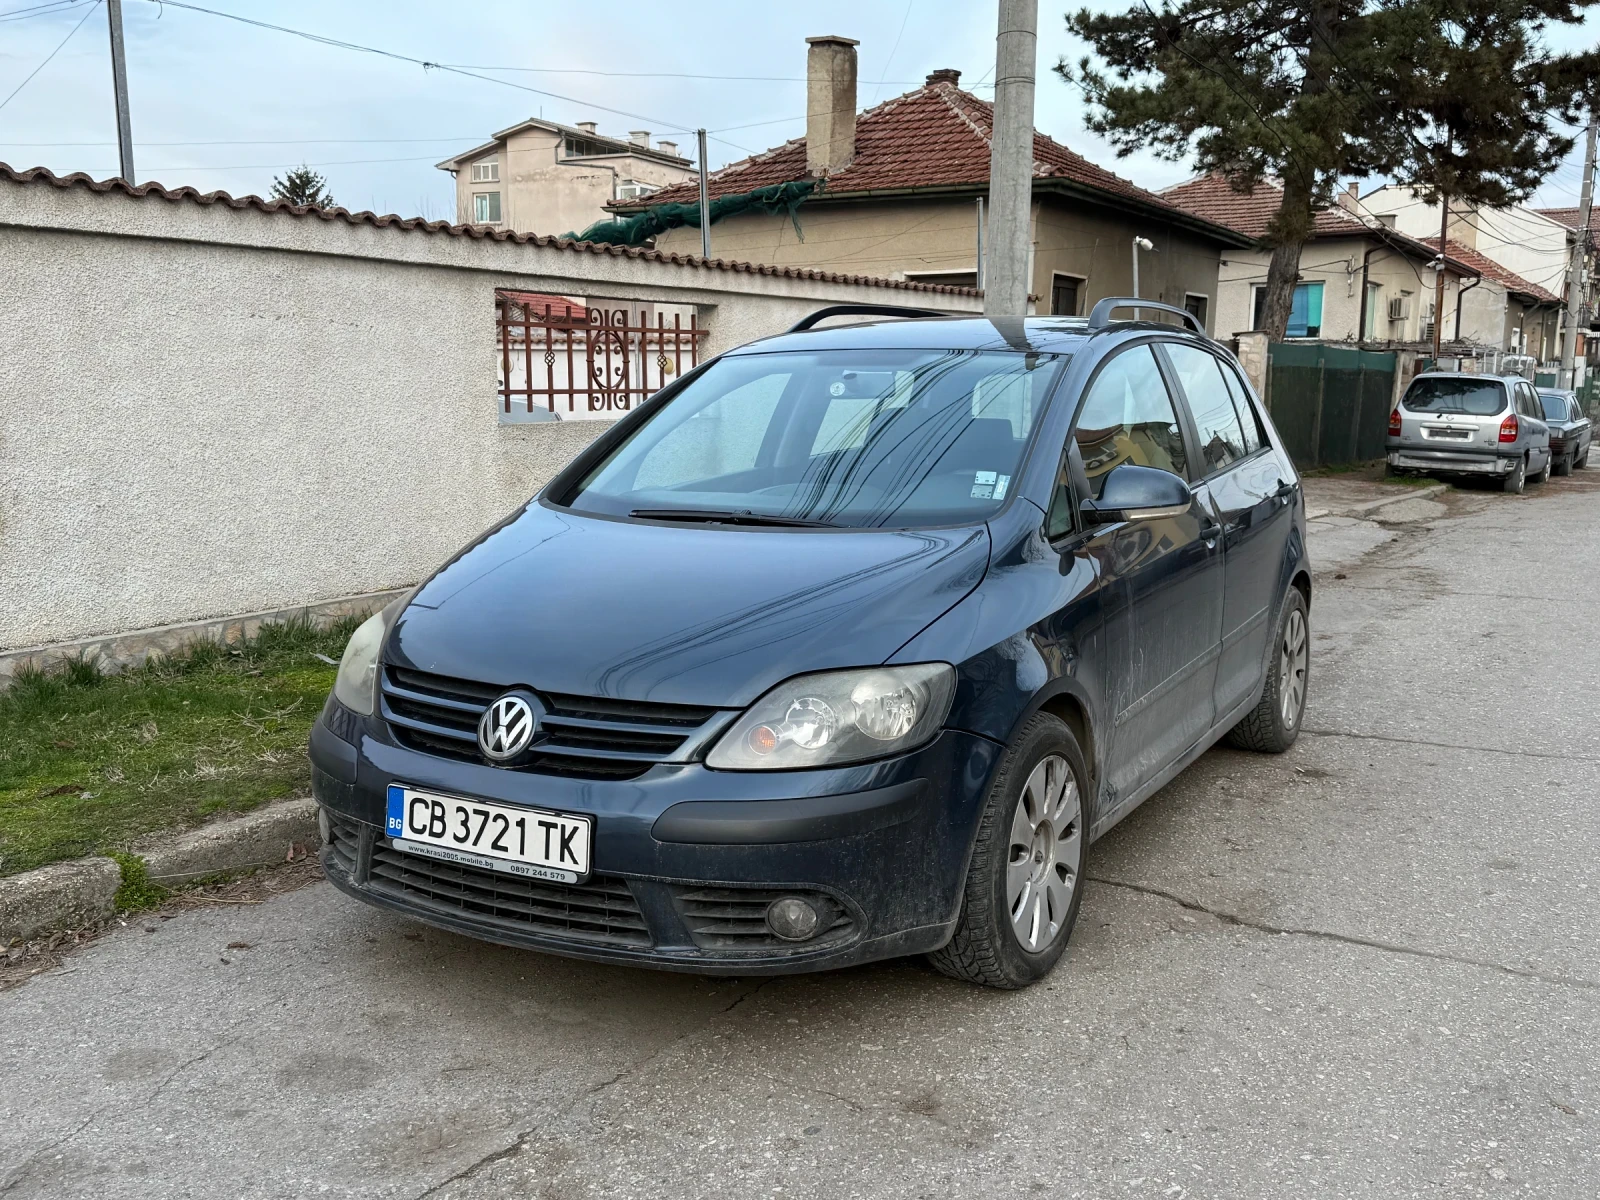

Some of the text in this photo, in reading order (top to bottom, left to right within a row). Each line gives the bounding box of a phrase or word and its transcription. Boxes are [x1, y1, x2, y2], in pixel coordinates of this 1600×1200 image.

[389, 817, 402, 830] BG
[408, 797, 580, 866] CB 3721 TK
[408, 844, 494, 869] www.krasi2005.mobile.bg
[510, 865, 566, 881] 0897 244 579
